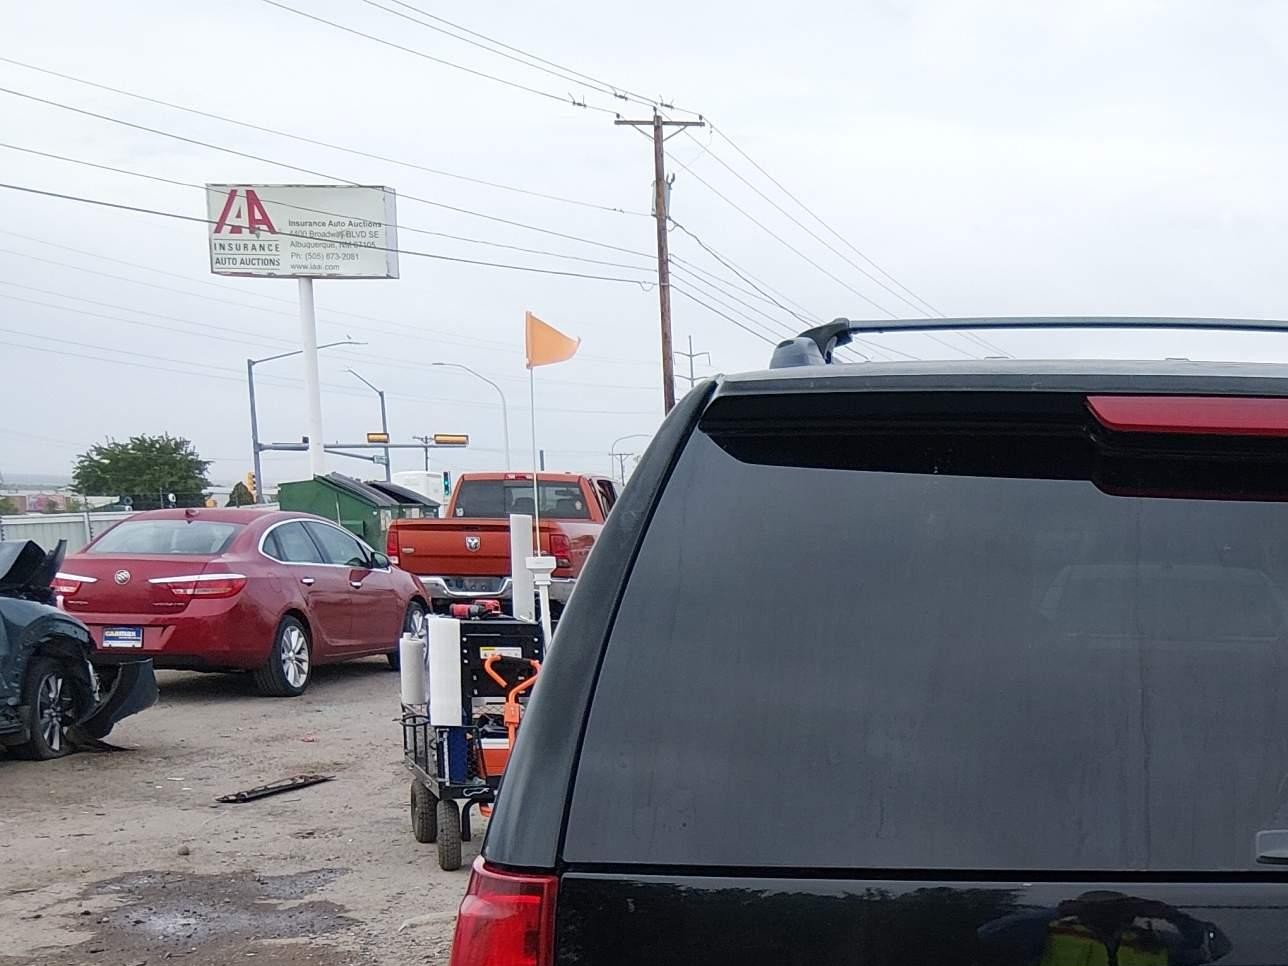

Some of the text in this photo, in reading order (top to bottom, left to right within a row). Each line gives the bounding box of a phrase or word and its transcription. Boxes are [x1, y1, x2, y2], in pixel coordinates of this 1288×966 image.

[348, 220, 382, 228] Auctions
[368, 231, 379, 239] SE
[213, 242, 280, 252] INSURANCE
[215, 257, 280, 267] AUTO AUCTIONS
